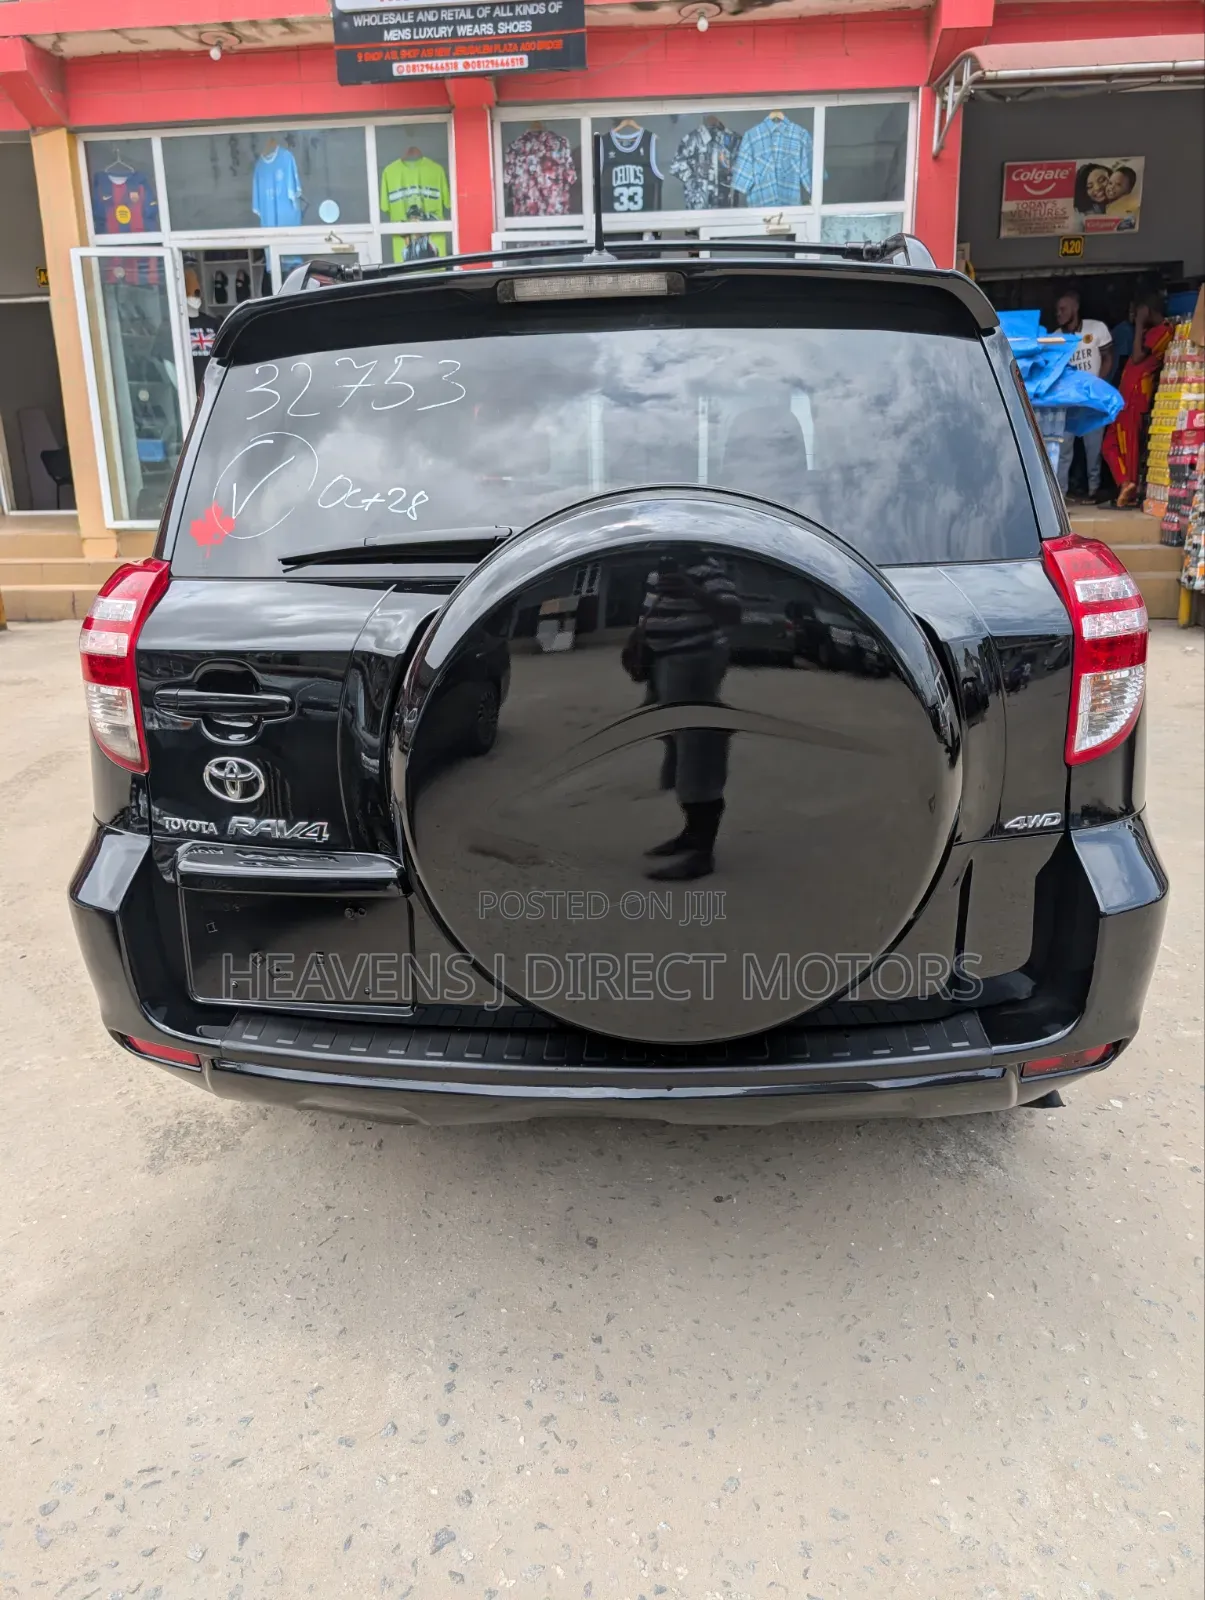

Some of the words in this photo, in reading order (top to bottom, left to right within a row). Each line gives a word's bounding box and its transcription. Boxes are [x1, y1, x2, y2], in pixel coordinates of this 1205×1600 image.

[353, 11, 414, 27] WHOLESALE
[416, 10, 439, 22] AND
[440, 8, 474, 21] RETAIL
[476, 6, 491, 19] OF
[492, 5, 513, 17] ALL
[515, 2, 546, 16] KINDS
[547, 1, 563, 14] OF
[383, 28, 412, 42] MENS
[413, 25, 454, 39] LUXURY
[456, 23, 496, 37] WEARS,
[498, 20, 533, 34] SHOES
[494, 42, 518, 53] PLAZA
[1011, 168, 1070, 184] Colgate
[613, 186, 644, 211] 33
[1015, 200, 1058, 210] TODAY'S
[1010, 207, 1068, 219] VENTURES
[1062, 240, 1081, 254] A20
[246, 354, 466, 420] 32753
[162, 816, 219, 836] TOYOTA
[227, 815, 330, 843] RAV4
[1004, 812, 1062, 830] 4WD
